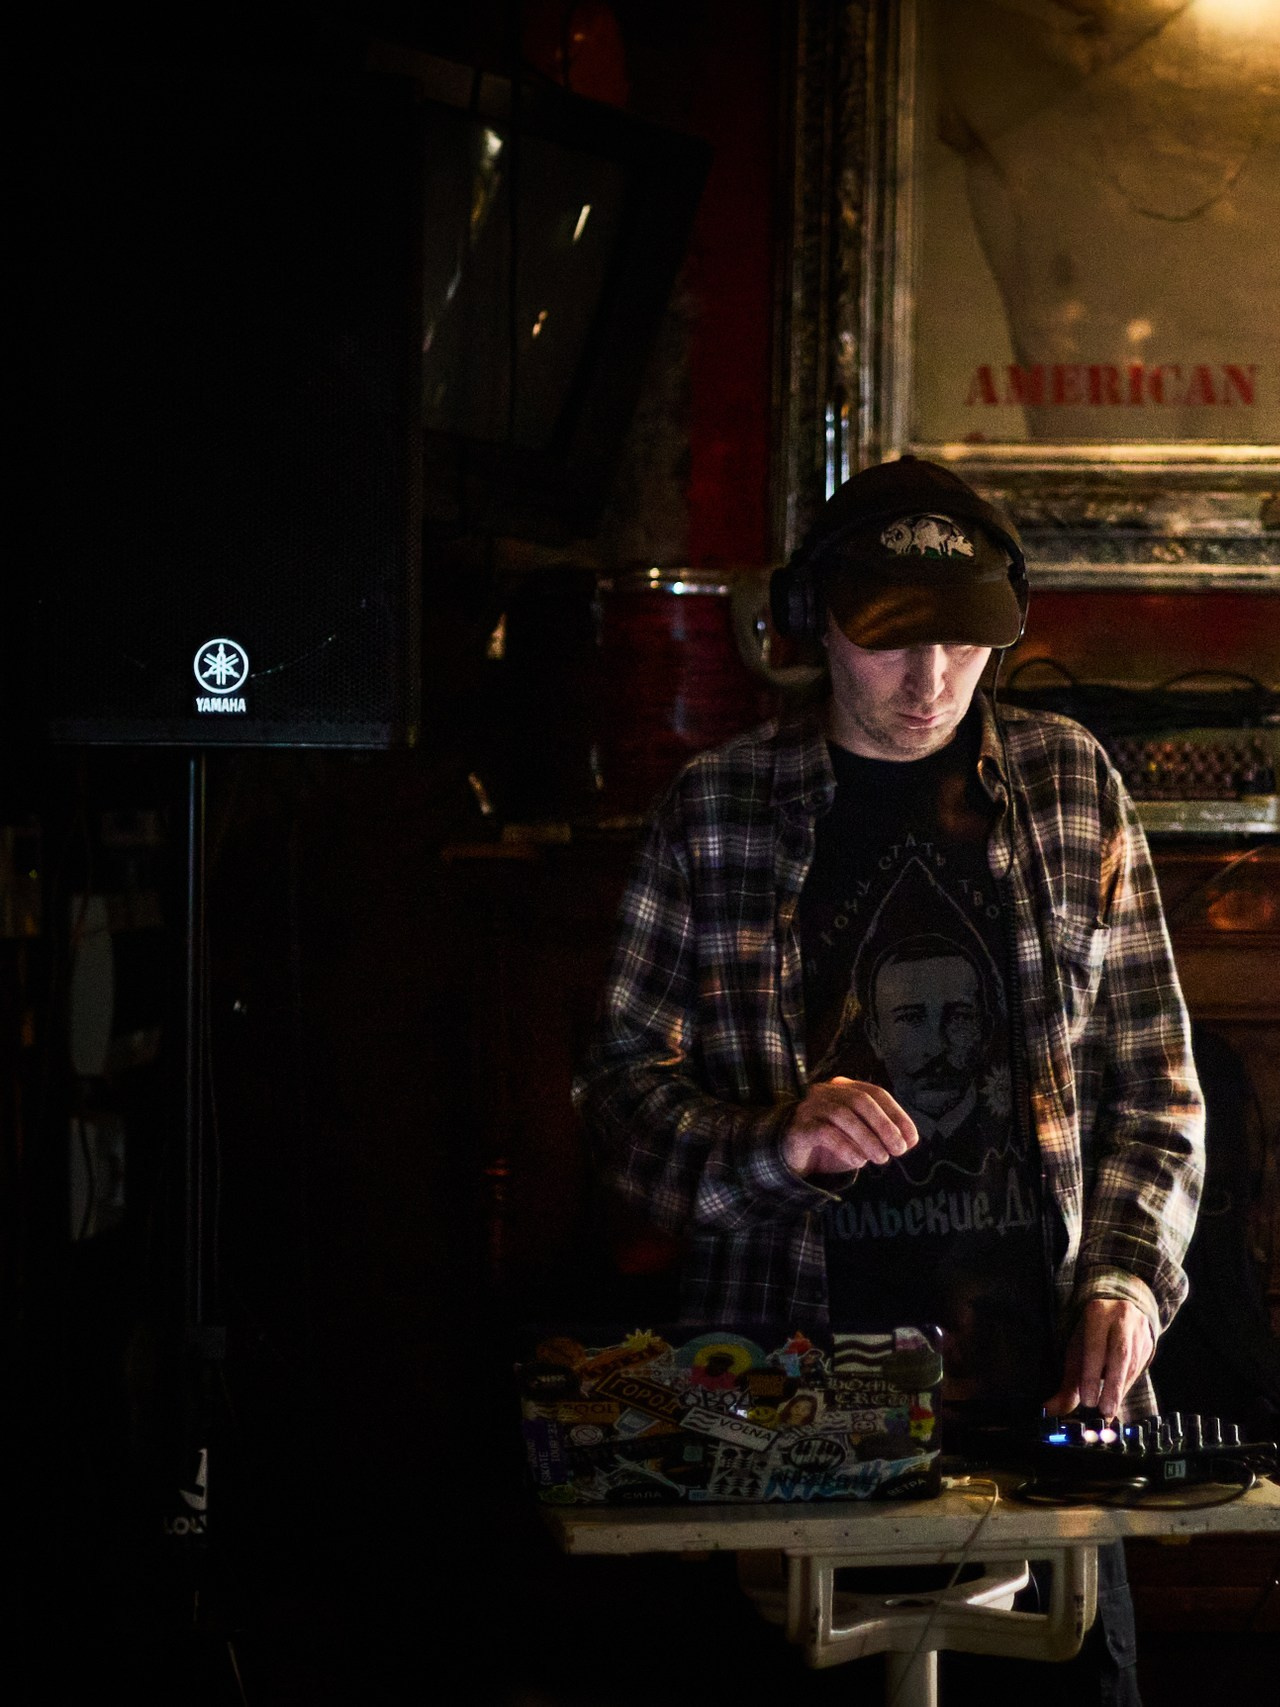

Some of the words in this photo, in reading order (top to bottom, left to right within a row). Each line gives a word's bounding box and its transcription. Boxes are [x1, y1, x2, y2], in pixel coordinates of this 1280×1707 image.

[966, 364, 1257, 406] AMERICAN
[196, 697, 246, 712] YAMAHA
[610, 1378, 678, 1417] ГОРОД
[720, 1418, 772, 1442] VOLNA
[622, 1490, 663, 1500] СИЛА
